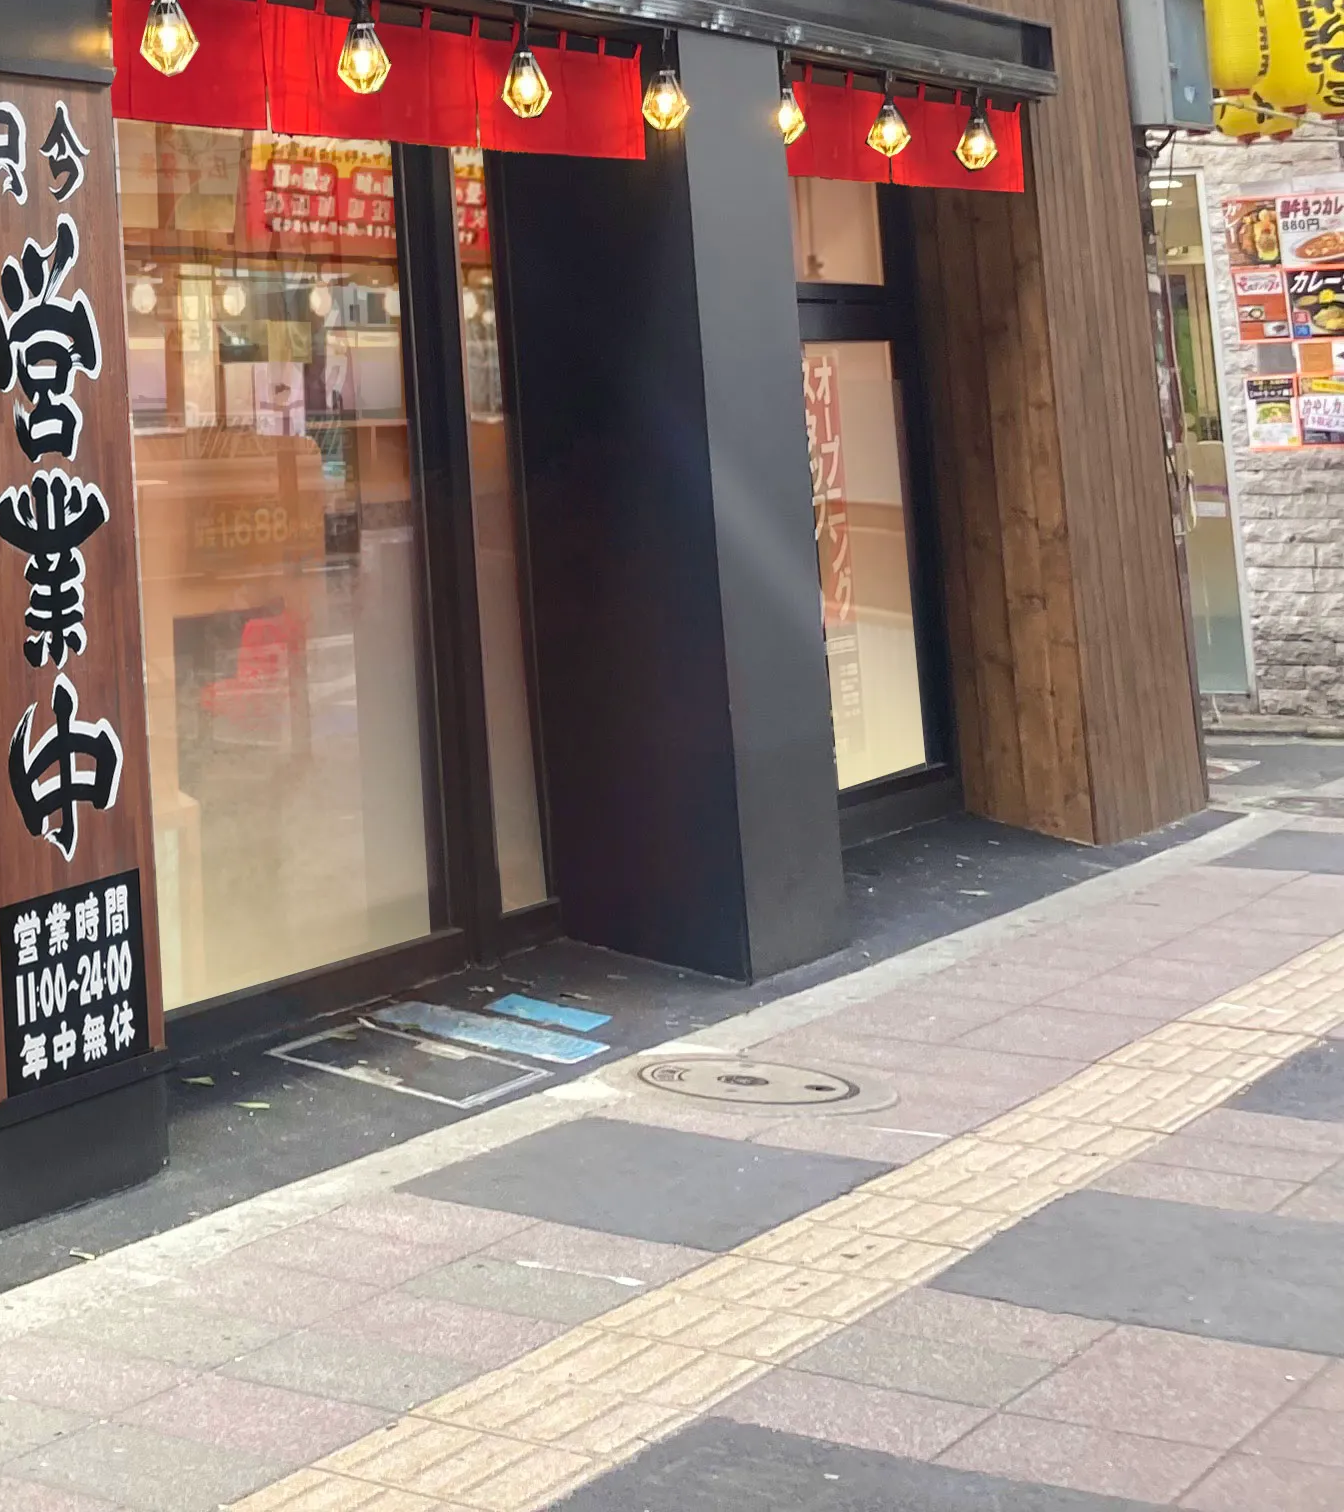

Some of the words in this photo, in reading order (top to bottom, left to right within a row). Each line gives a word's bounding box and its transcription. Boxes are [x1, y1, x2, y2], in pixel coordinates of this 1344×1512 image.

[1289, 270, 1344, 294] カレー
[13, 884, 130, 965] 営業時間
[19, 1001, 136, 1080] 年中無休
